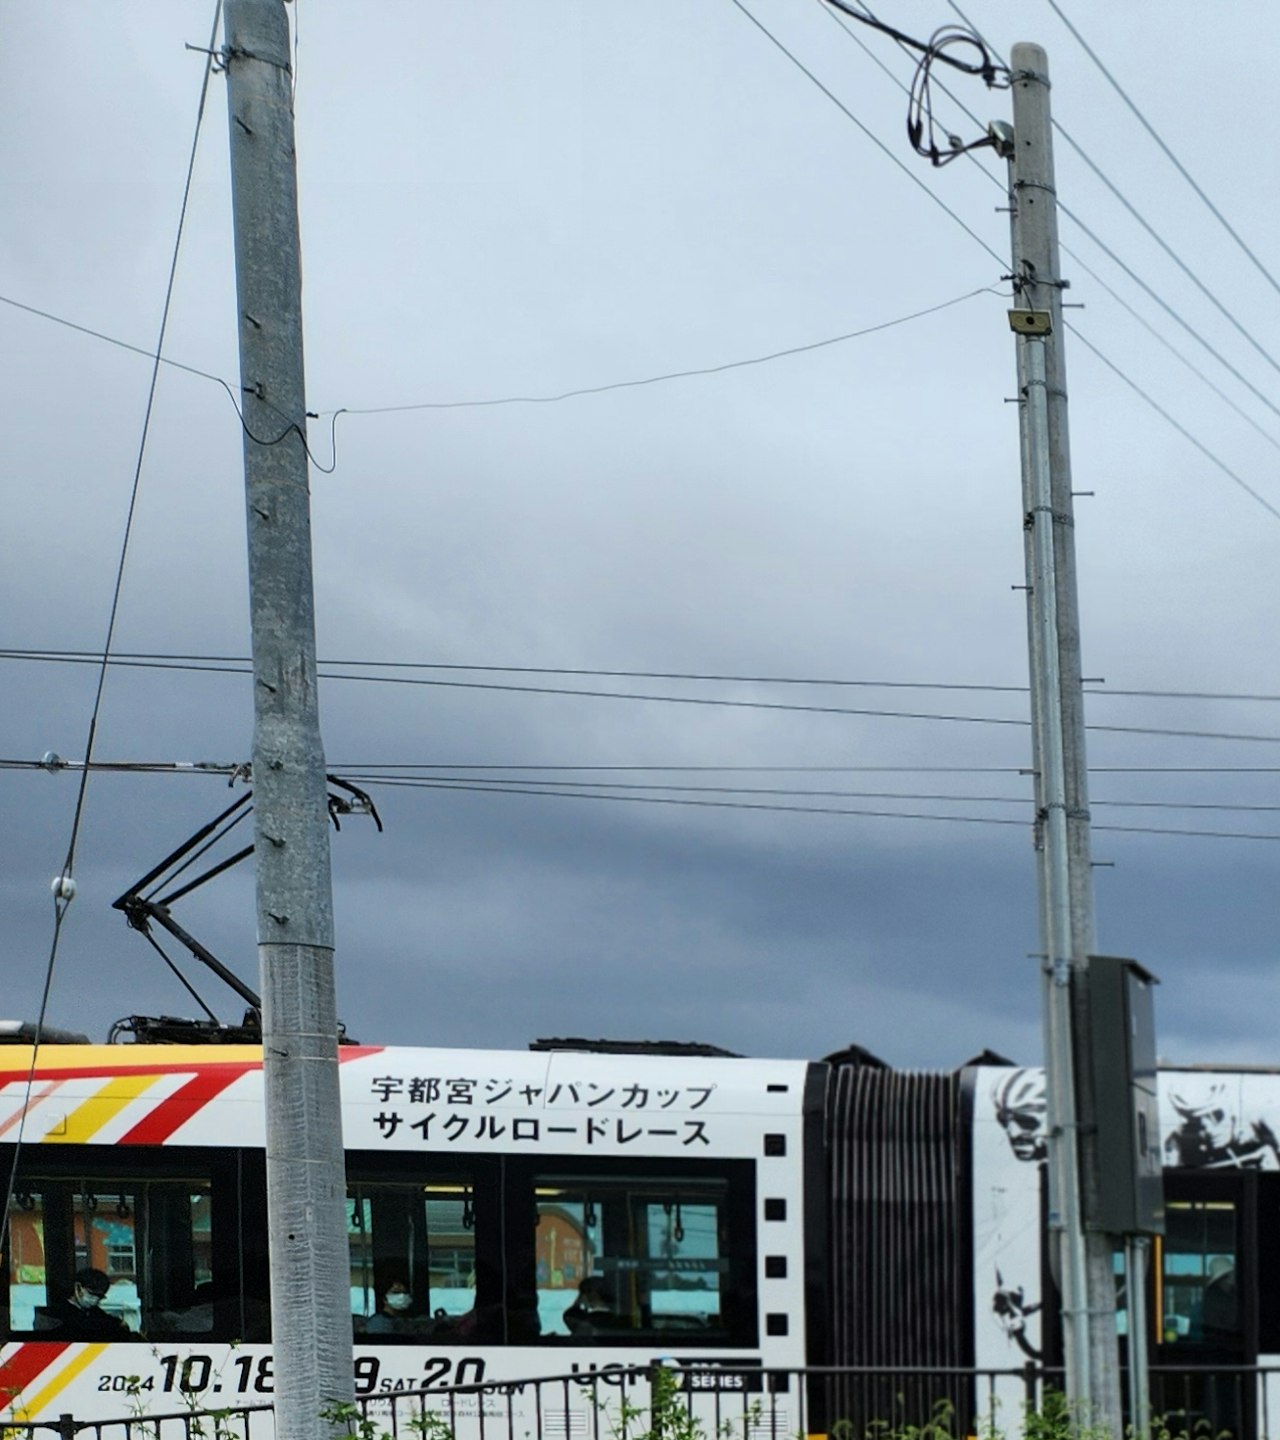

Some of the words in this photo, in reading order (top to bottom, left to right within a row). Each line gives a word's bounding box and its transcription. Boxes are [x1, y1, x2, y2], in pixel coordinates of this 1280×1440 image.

[371, 1076, 718, 1109] 宇都宮ジャパンカップ
[373, 1111, 711, 1145] サイクルロードレース
[379, 1378, 417, 1394] SAT
[420, 1357, 486, 1394] 20
